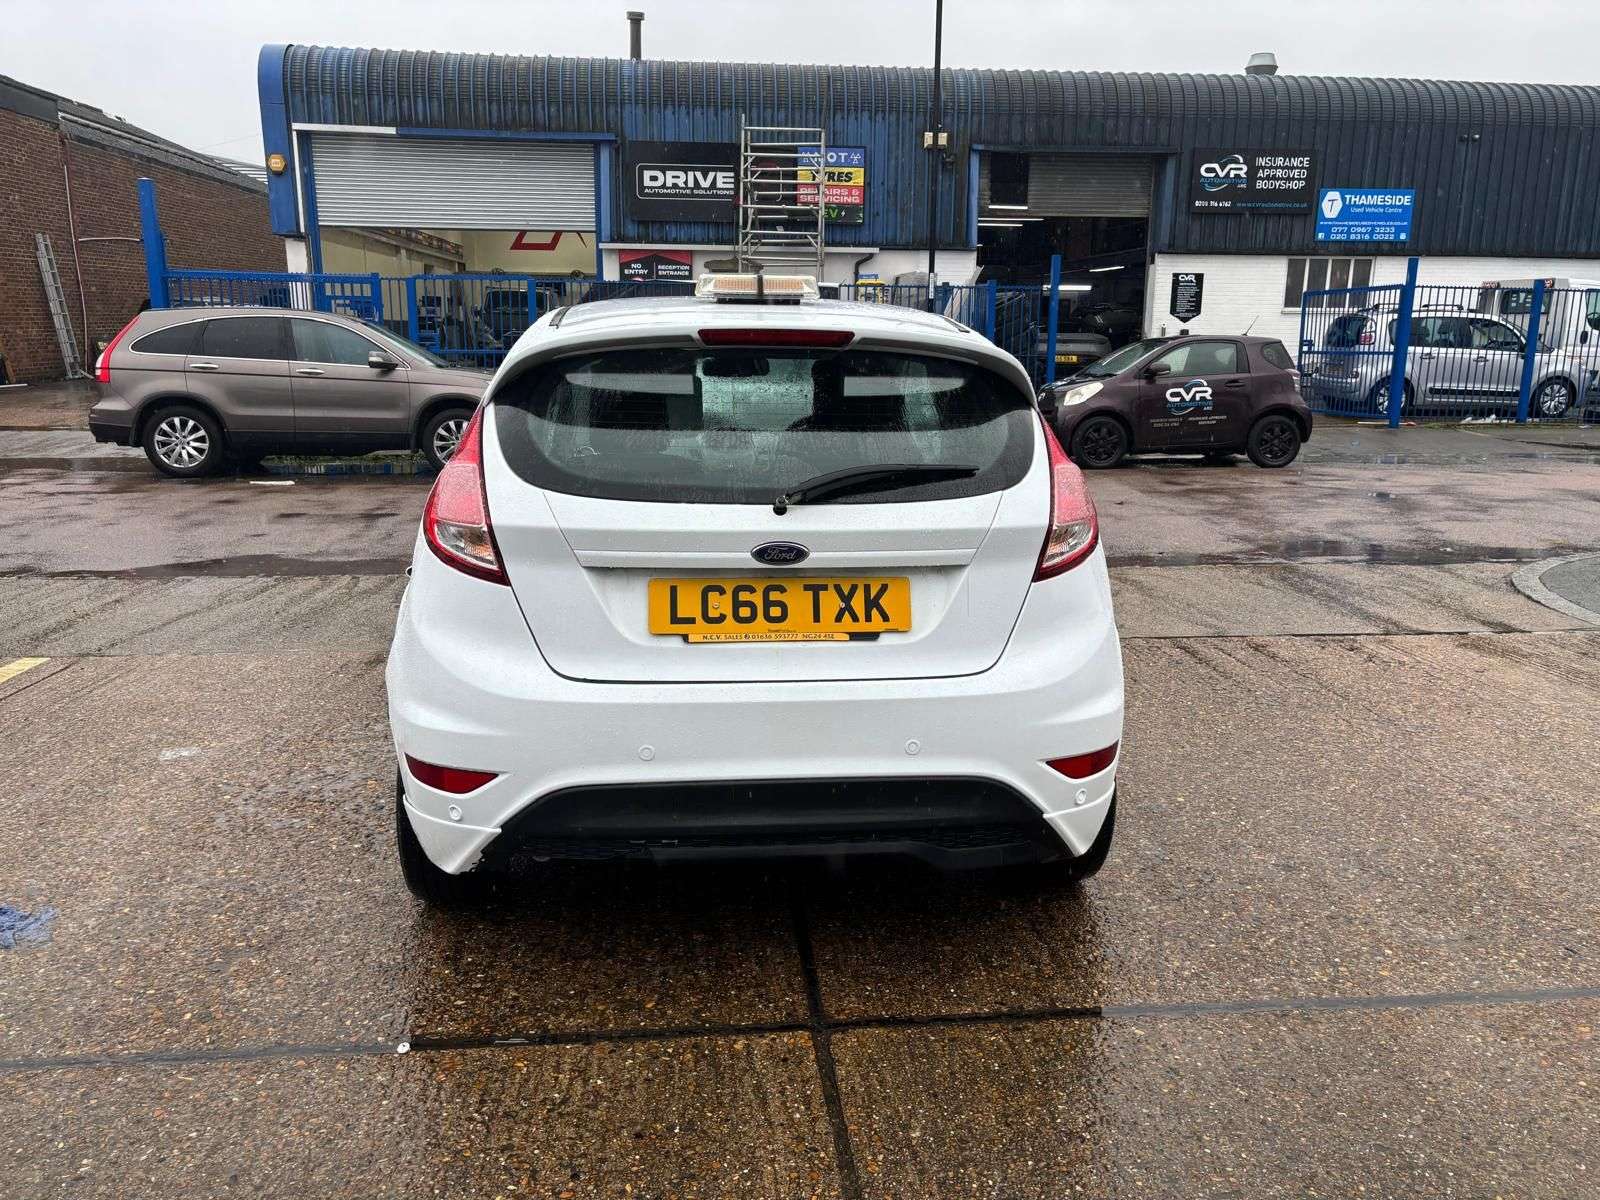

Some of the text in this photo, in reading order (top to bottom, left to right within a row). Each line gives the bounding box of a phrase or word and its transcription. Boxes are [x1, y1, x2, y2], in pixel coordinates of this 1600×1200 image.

[1255, 157, 1310, 167] INSURANCE
[1200, 163, 1248, 178] CVR
[1257, 169, 1307, 179] APPROVED
[643, 170, 735, 189] DRIVE
[1255, 180, 1306, 190] BODYSHOP
[852, 188, 860, 196] &
[1345, 194, 1412, 206] THAMESIDE
[1179, 274, 1196, 282] CVR
[1165, 386, 1213, 402] CVR
[764, 546, 797, 561] Ford
[669, 583, 890, 625] LC66 TXK
